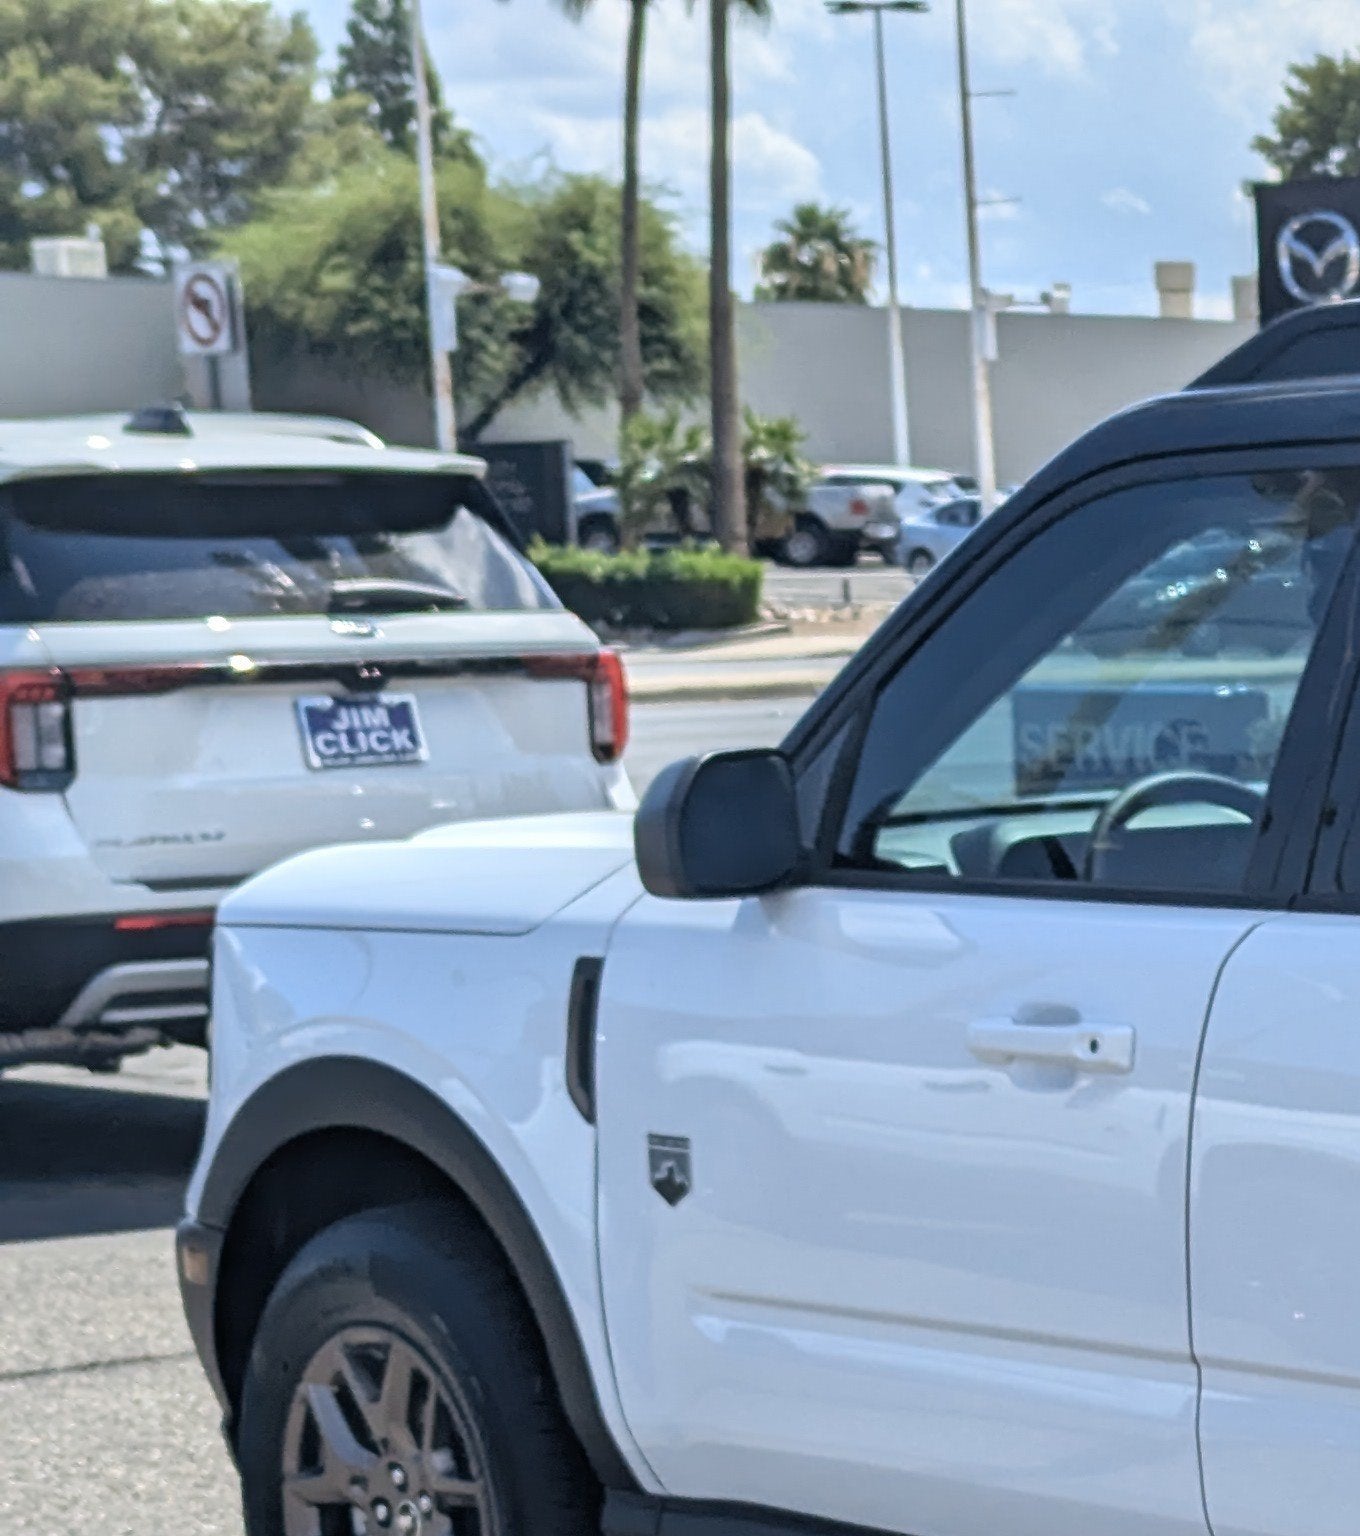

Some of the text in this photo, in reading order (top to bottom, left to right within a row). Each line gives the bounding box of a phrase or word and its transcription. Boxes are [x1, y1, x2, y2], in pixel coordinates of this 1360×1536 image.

[331, 706, 391, 730] JIM
[315, 728, 415, 755] CLICK
[1020, 721, 1208, 773] SERVICE
